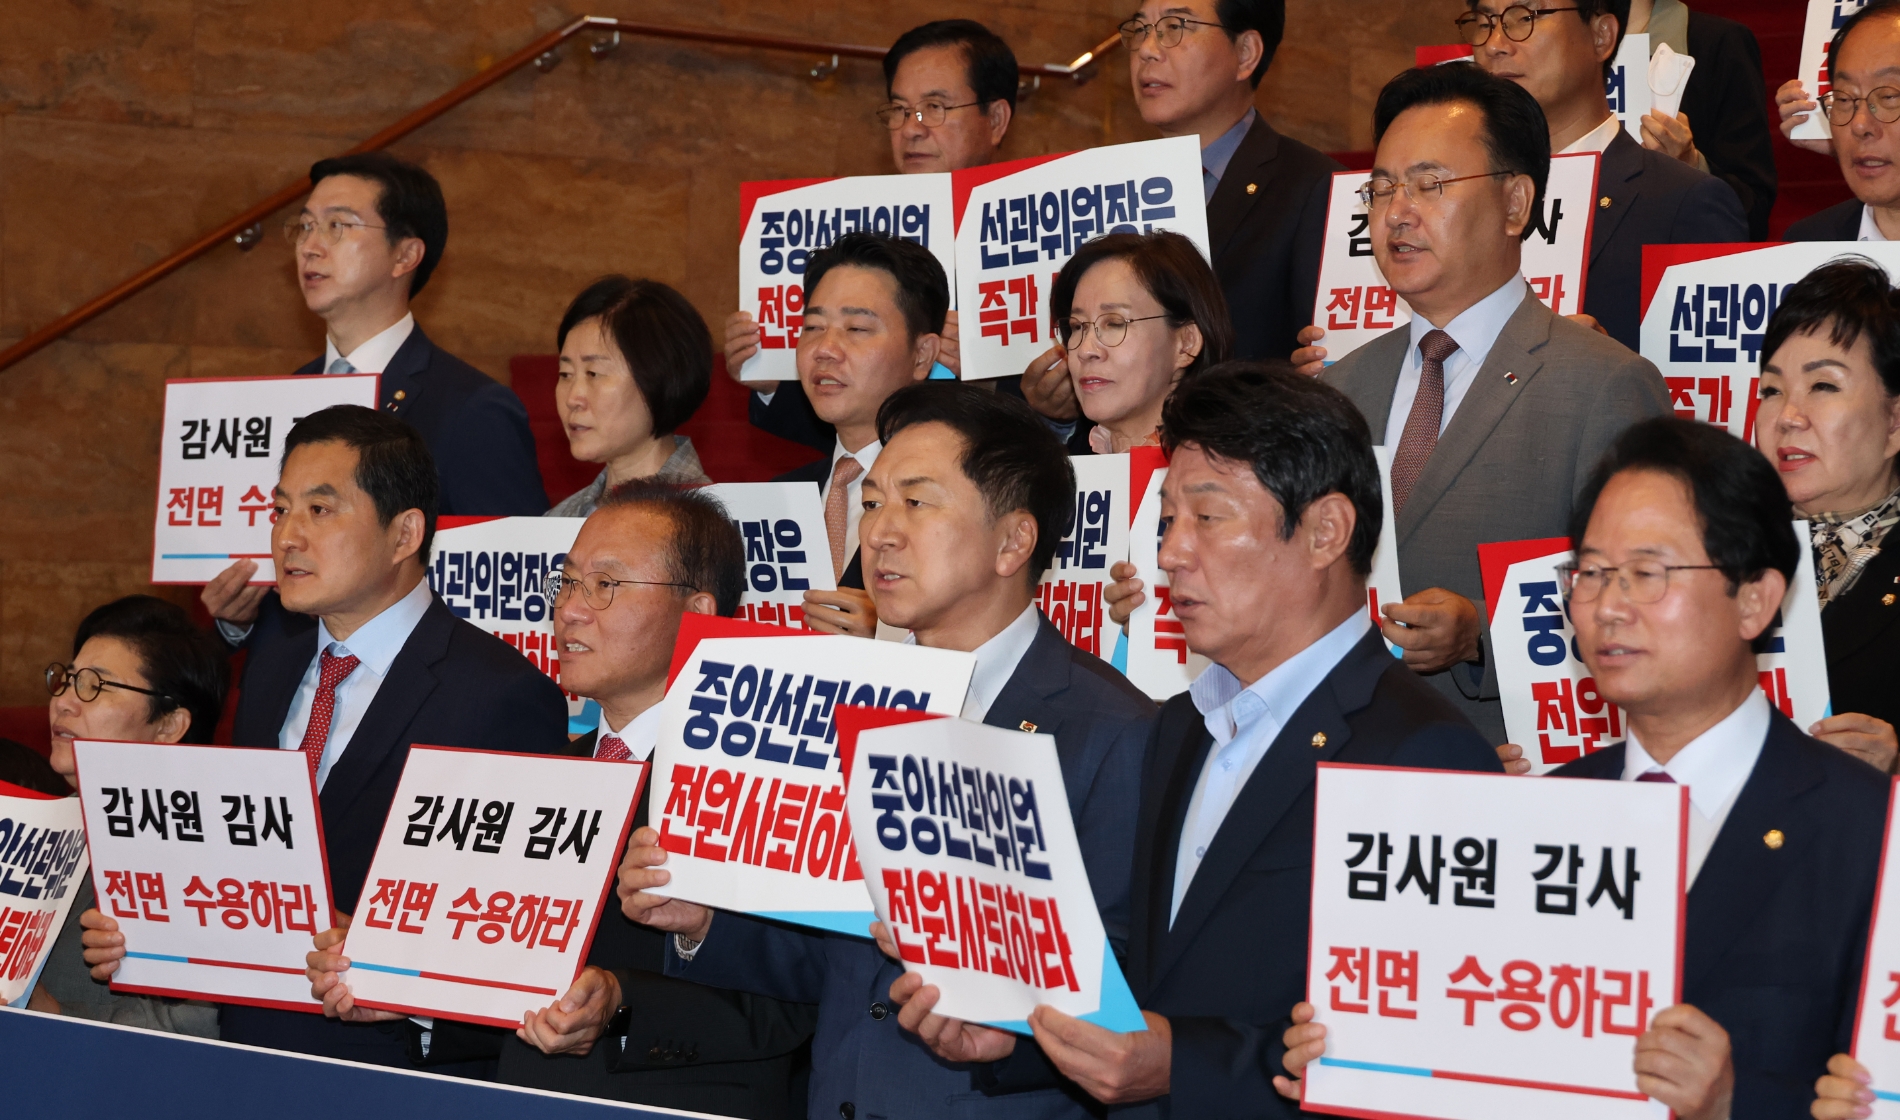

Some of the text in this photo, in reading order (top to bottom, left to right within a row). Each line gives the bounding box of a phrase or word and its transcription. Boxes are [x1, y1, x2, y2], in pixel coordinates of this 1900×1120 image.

[979, 274, 1038, 346] 즉각
[1326, 286, 1397, 331] 전면
[180, 416, 272, 459] 감사원
[167, 486, 224, 526] 전면
[101, 787, 293, 849] 감사원 감사
[404, 796, 602, 863] 감사원 감사
[868, 753, 1053, 881] 중앙선관위원
[104, 870, 317, 935] 전면 수용하라
[1345, 832, 1640, 920] 감사원 감사
[365, 878, 583, 953] 전면 수용하라
[1325, 946, 1653, 1038] 전면 수용하라
